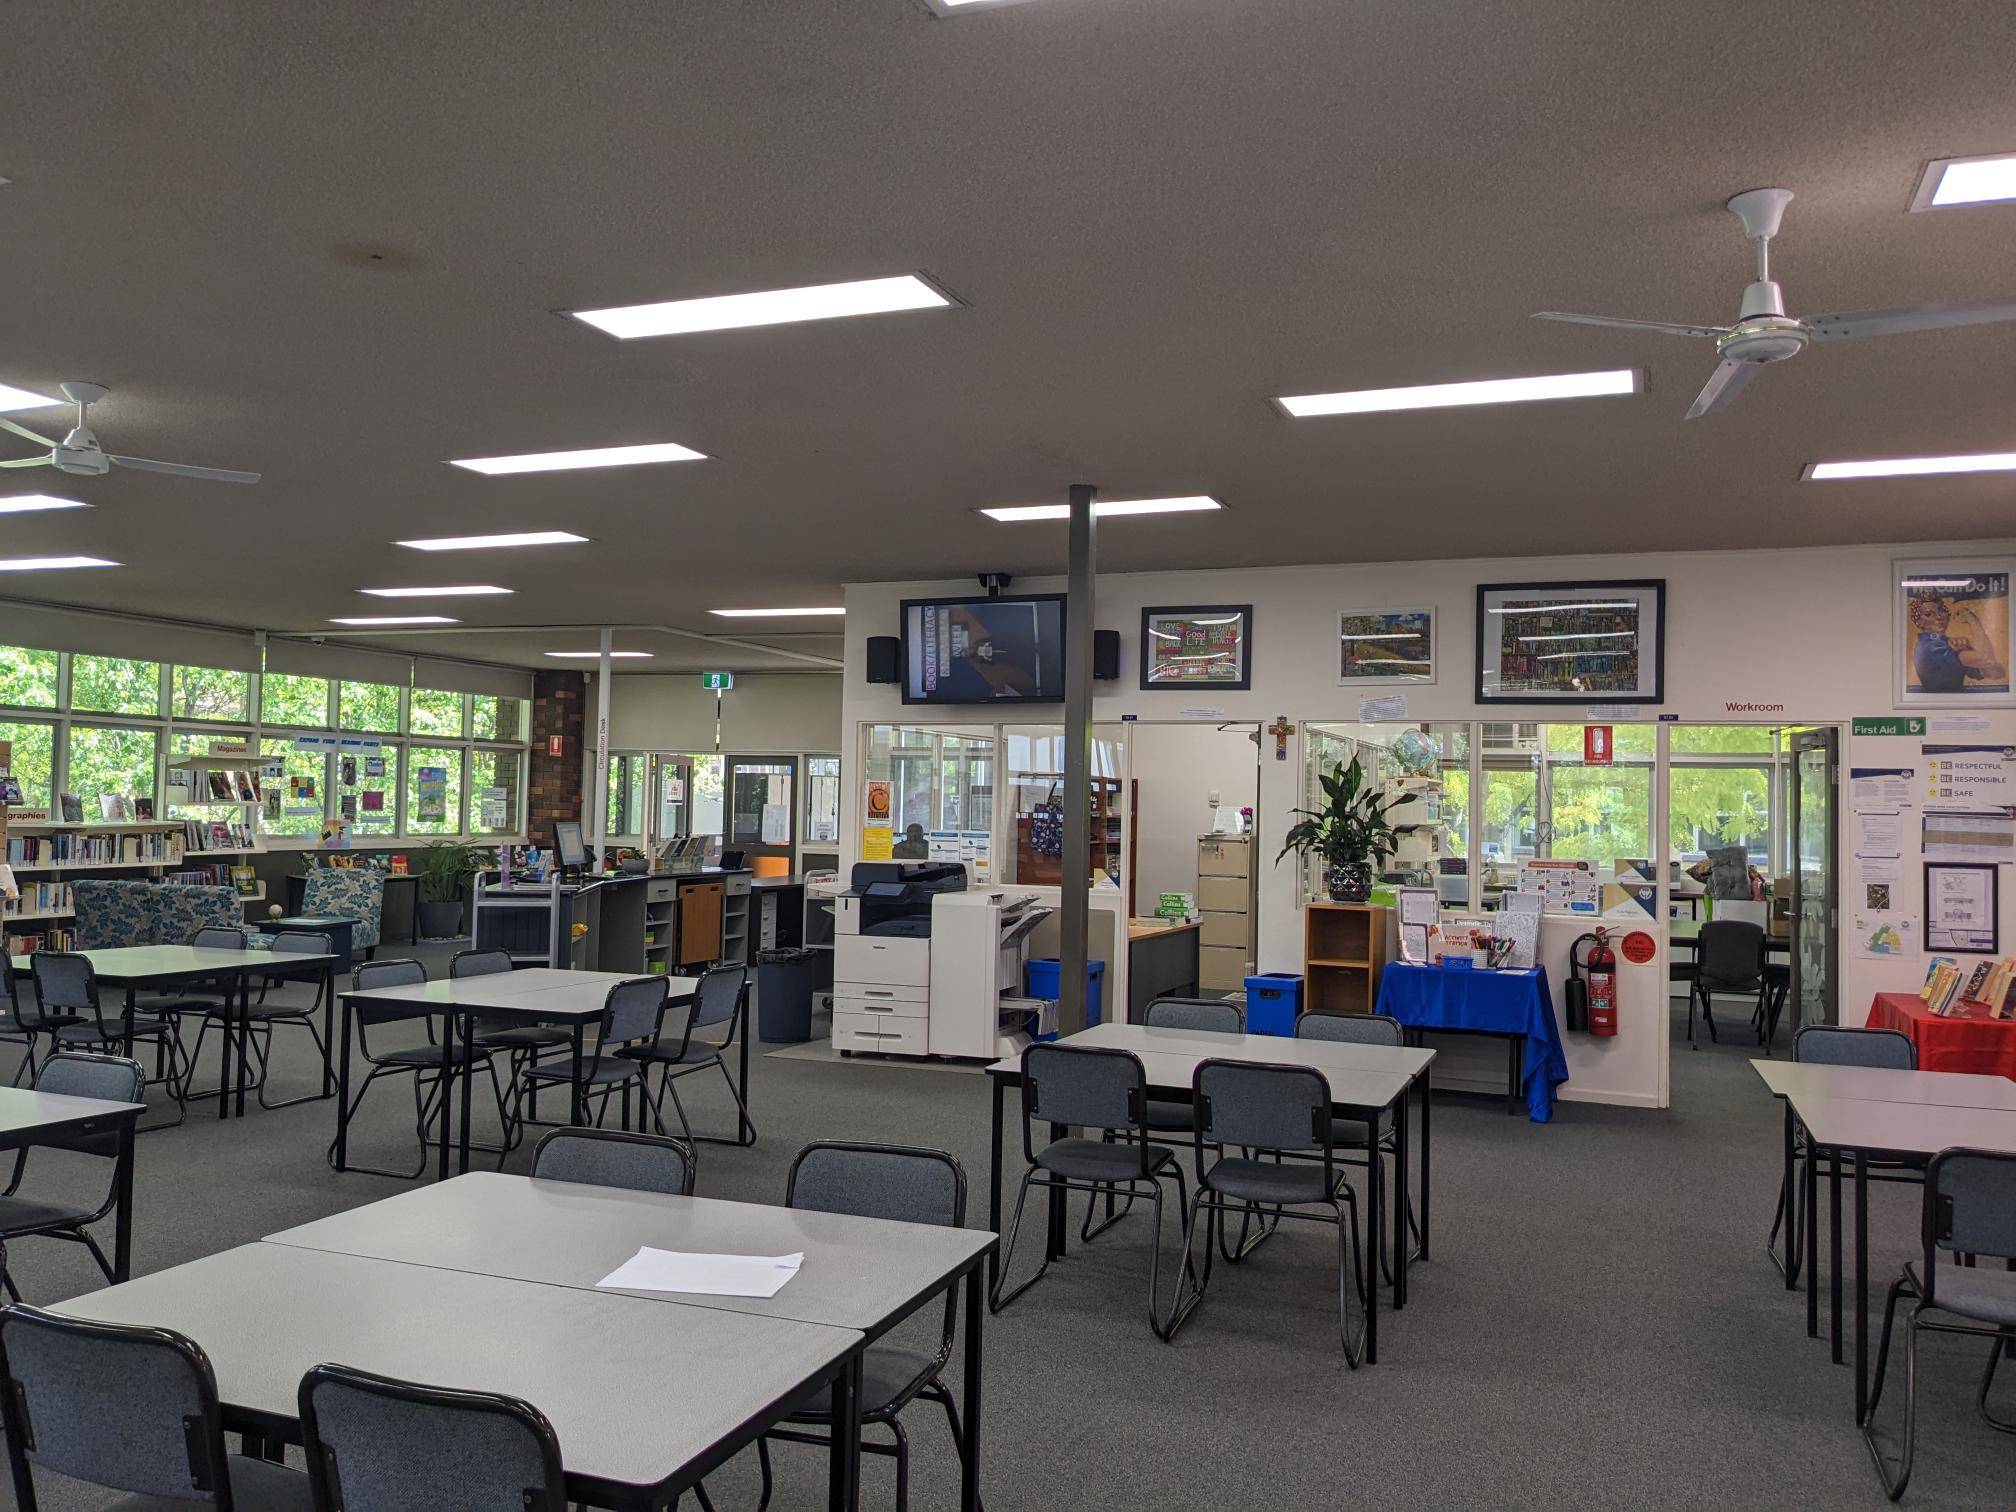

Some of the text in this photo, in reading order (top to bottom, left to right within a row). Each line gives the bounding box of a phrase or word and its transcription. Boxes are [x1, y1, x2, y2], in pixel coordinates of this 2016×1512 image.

[1965, 577, 1986, 593] Do
[1989, 576, 2005, 592] It!
[1185, 630, 1206, 638] Good
[1725, 702, 1784, 712] Workroom
[1854, 725, 1897, 734] First Aid
[217, 744, 247, 754] Magazines
[1941, 761, 1952, 769] BE
[1940, 775, 2007, 784] BE RESPONSIBLE
